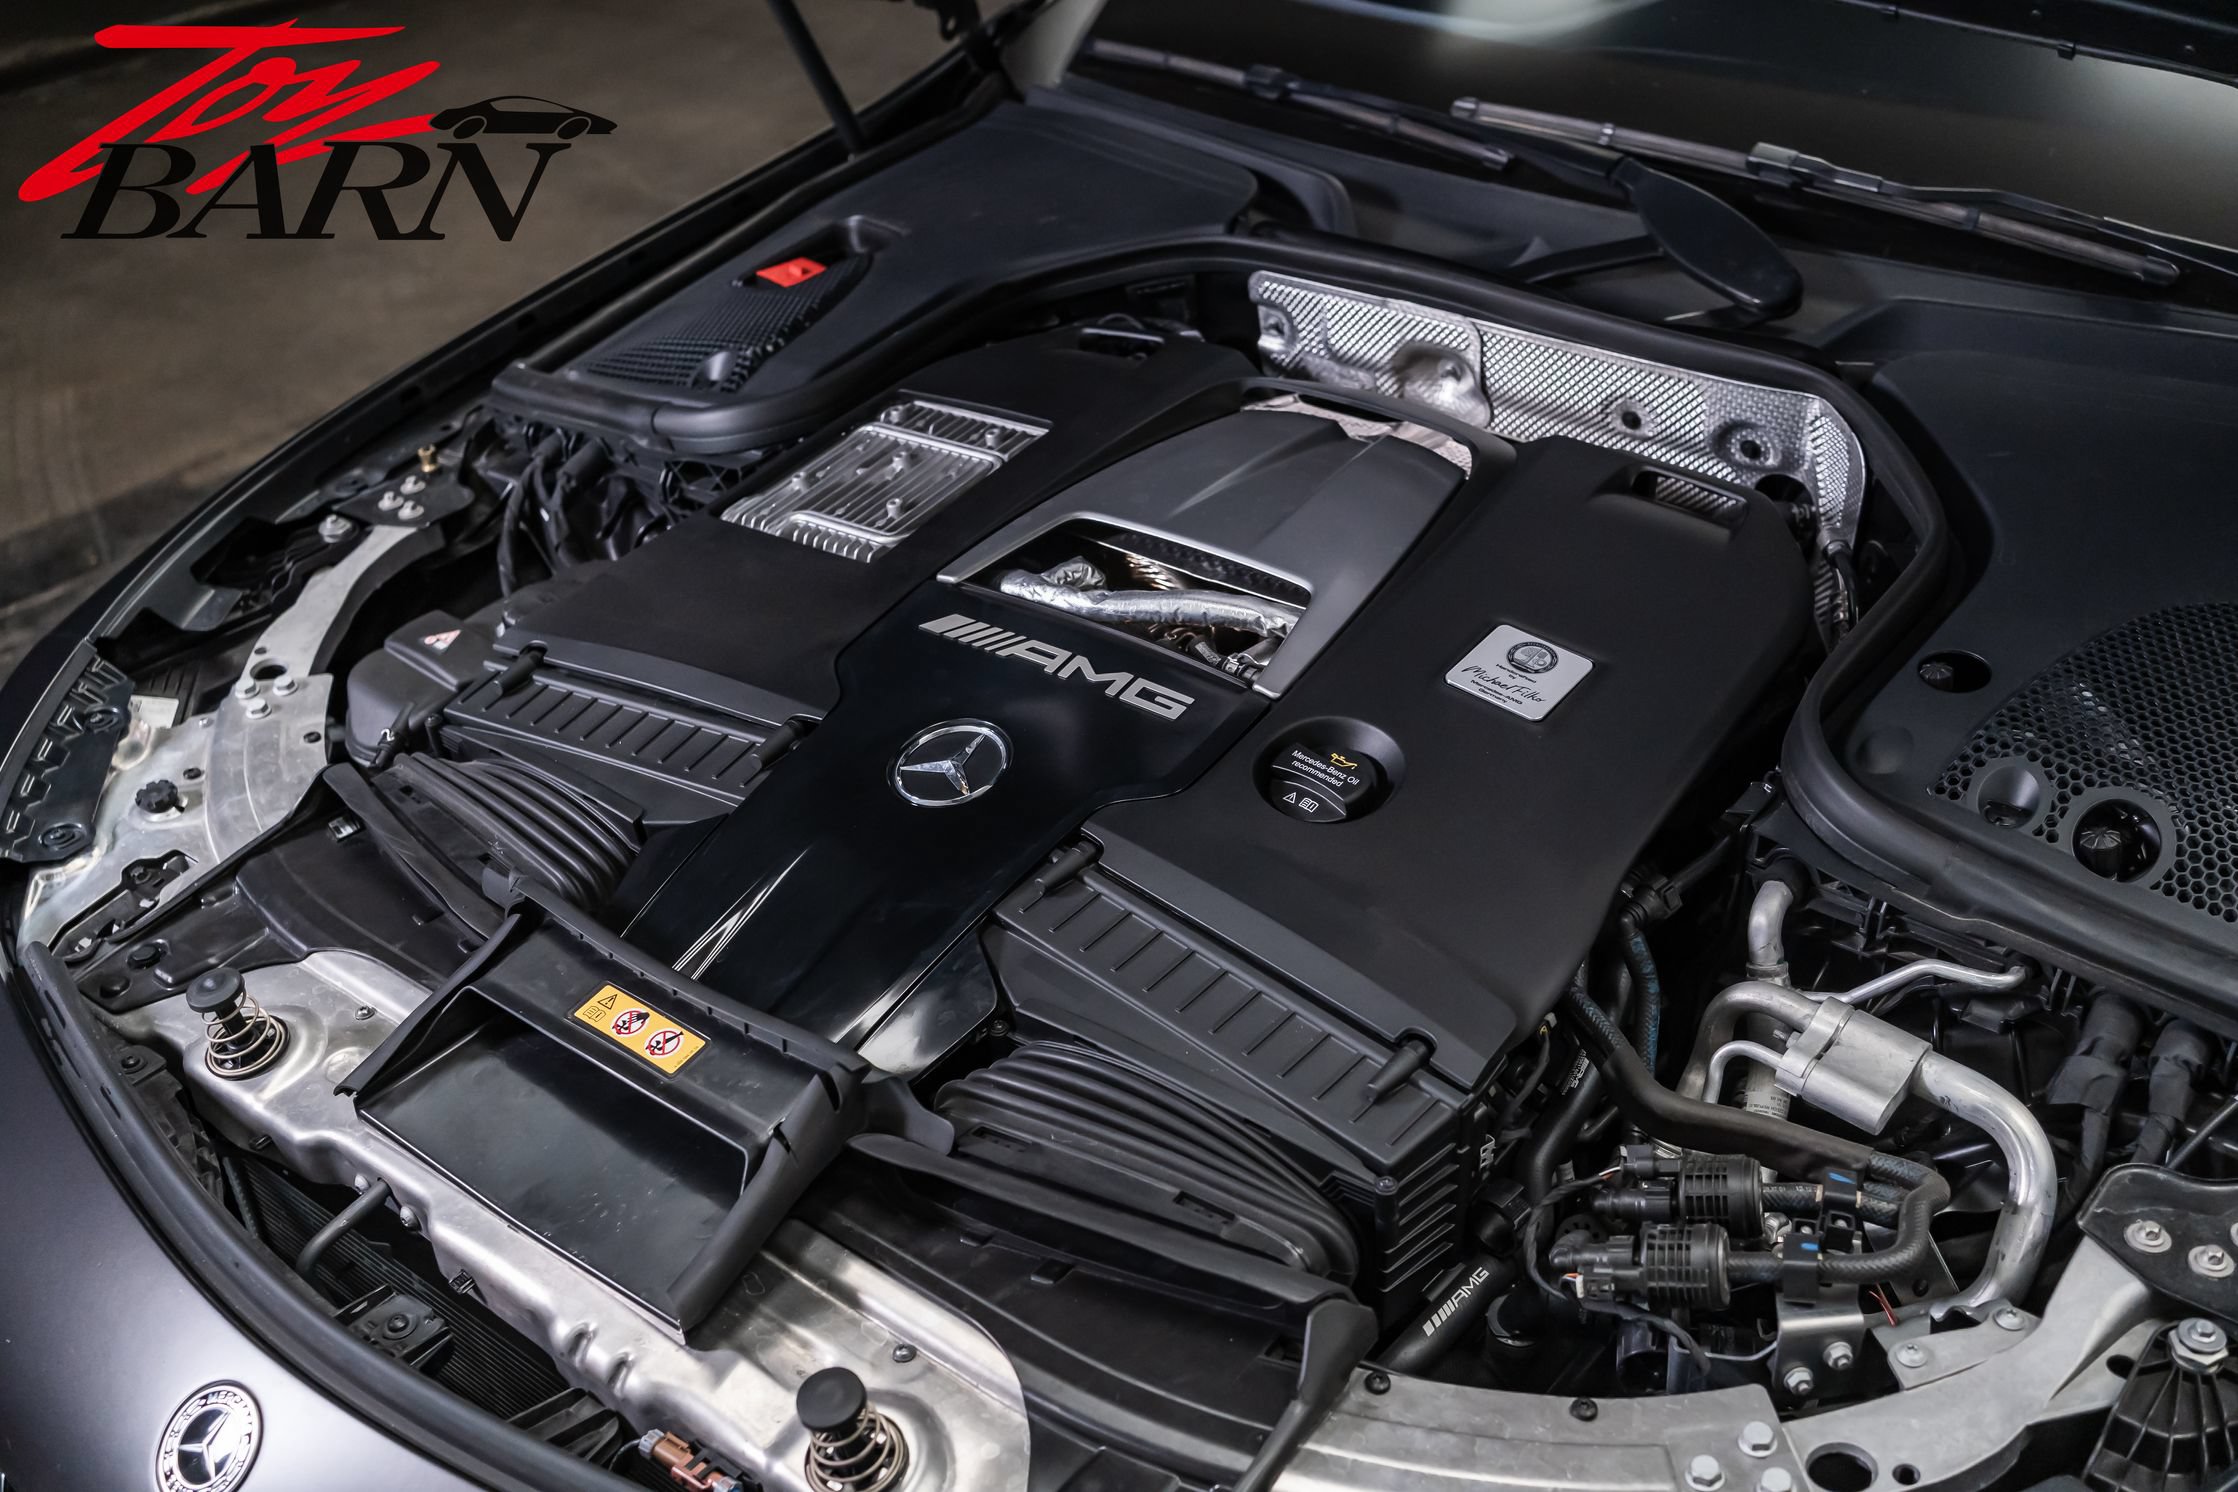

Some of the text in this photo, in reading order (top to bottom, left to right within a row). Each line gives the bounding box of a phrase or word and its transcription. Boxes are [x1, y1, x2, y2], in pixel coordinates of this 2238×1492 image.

[995, 639, 1196, 721] AMG
[1461, 665, 1516, 691] Michael
[1478, 688, 1508, 704] Germany
[1292, 750, 1360, 785] Mercedes-Benz Oil
[1292, 760, 1344, 787] recommended
[1451, 1267, 1490, 1308] AMG
